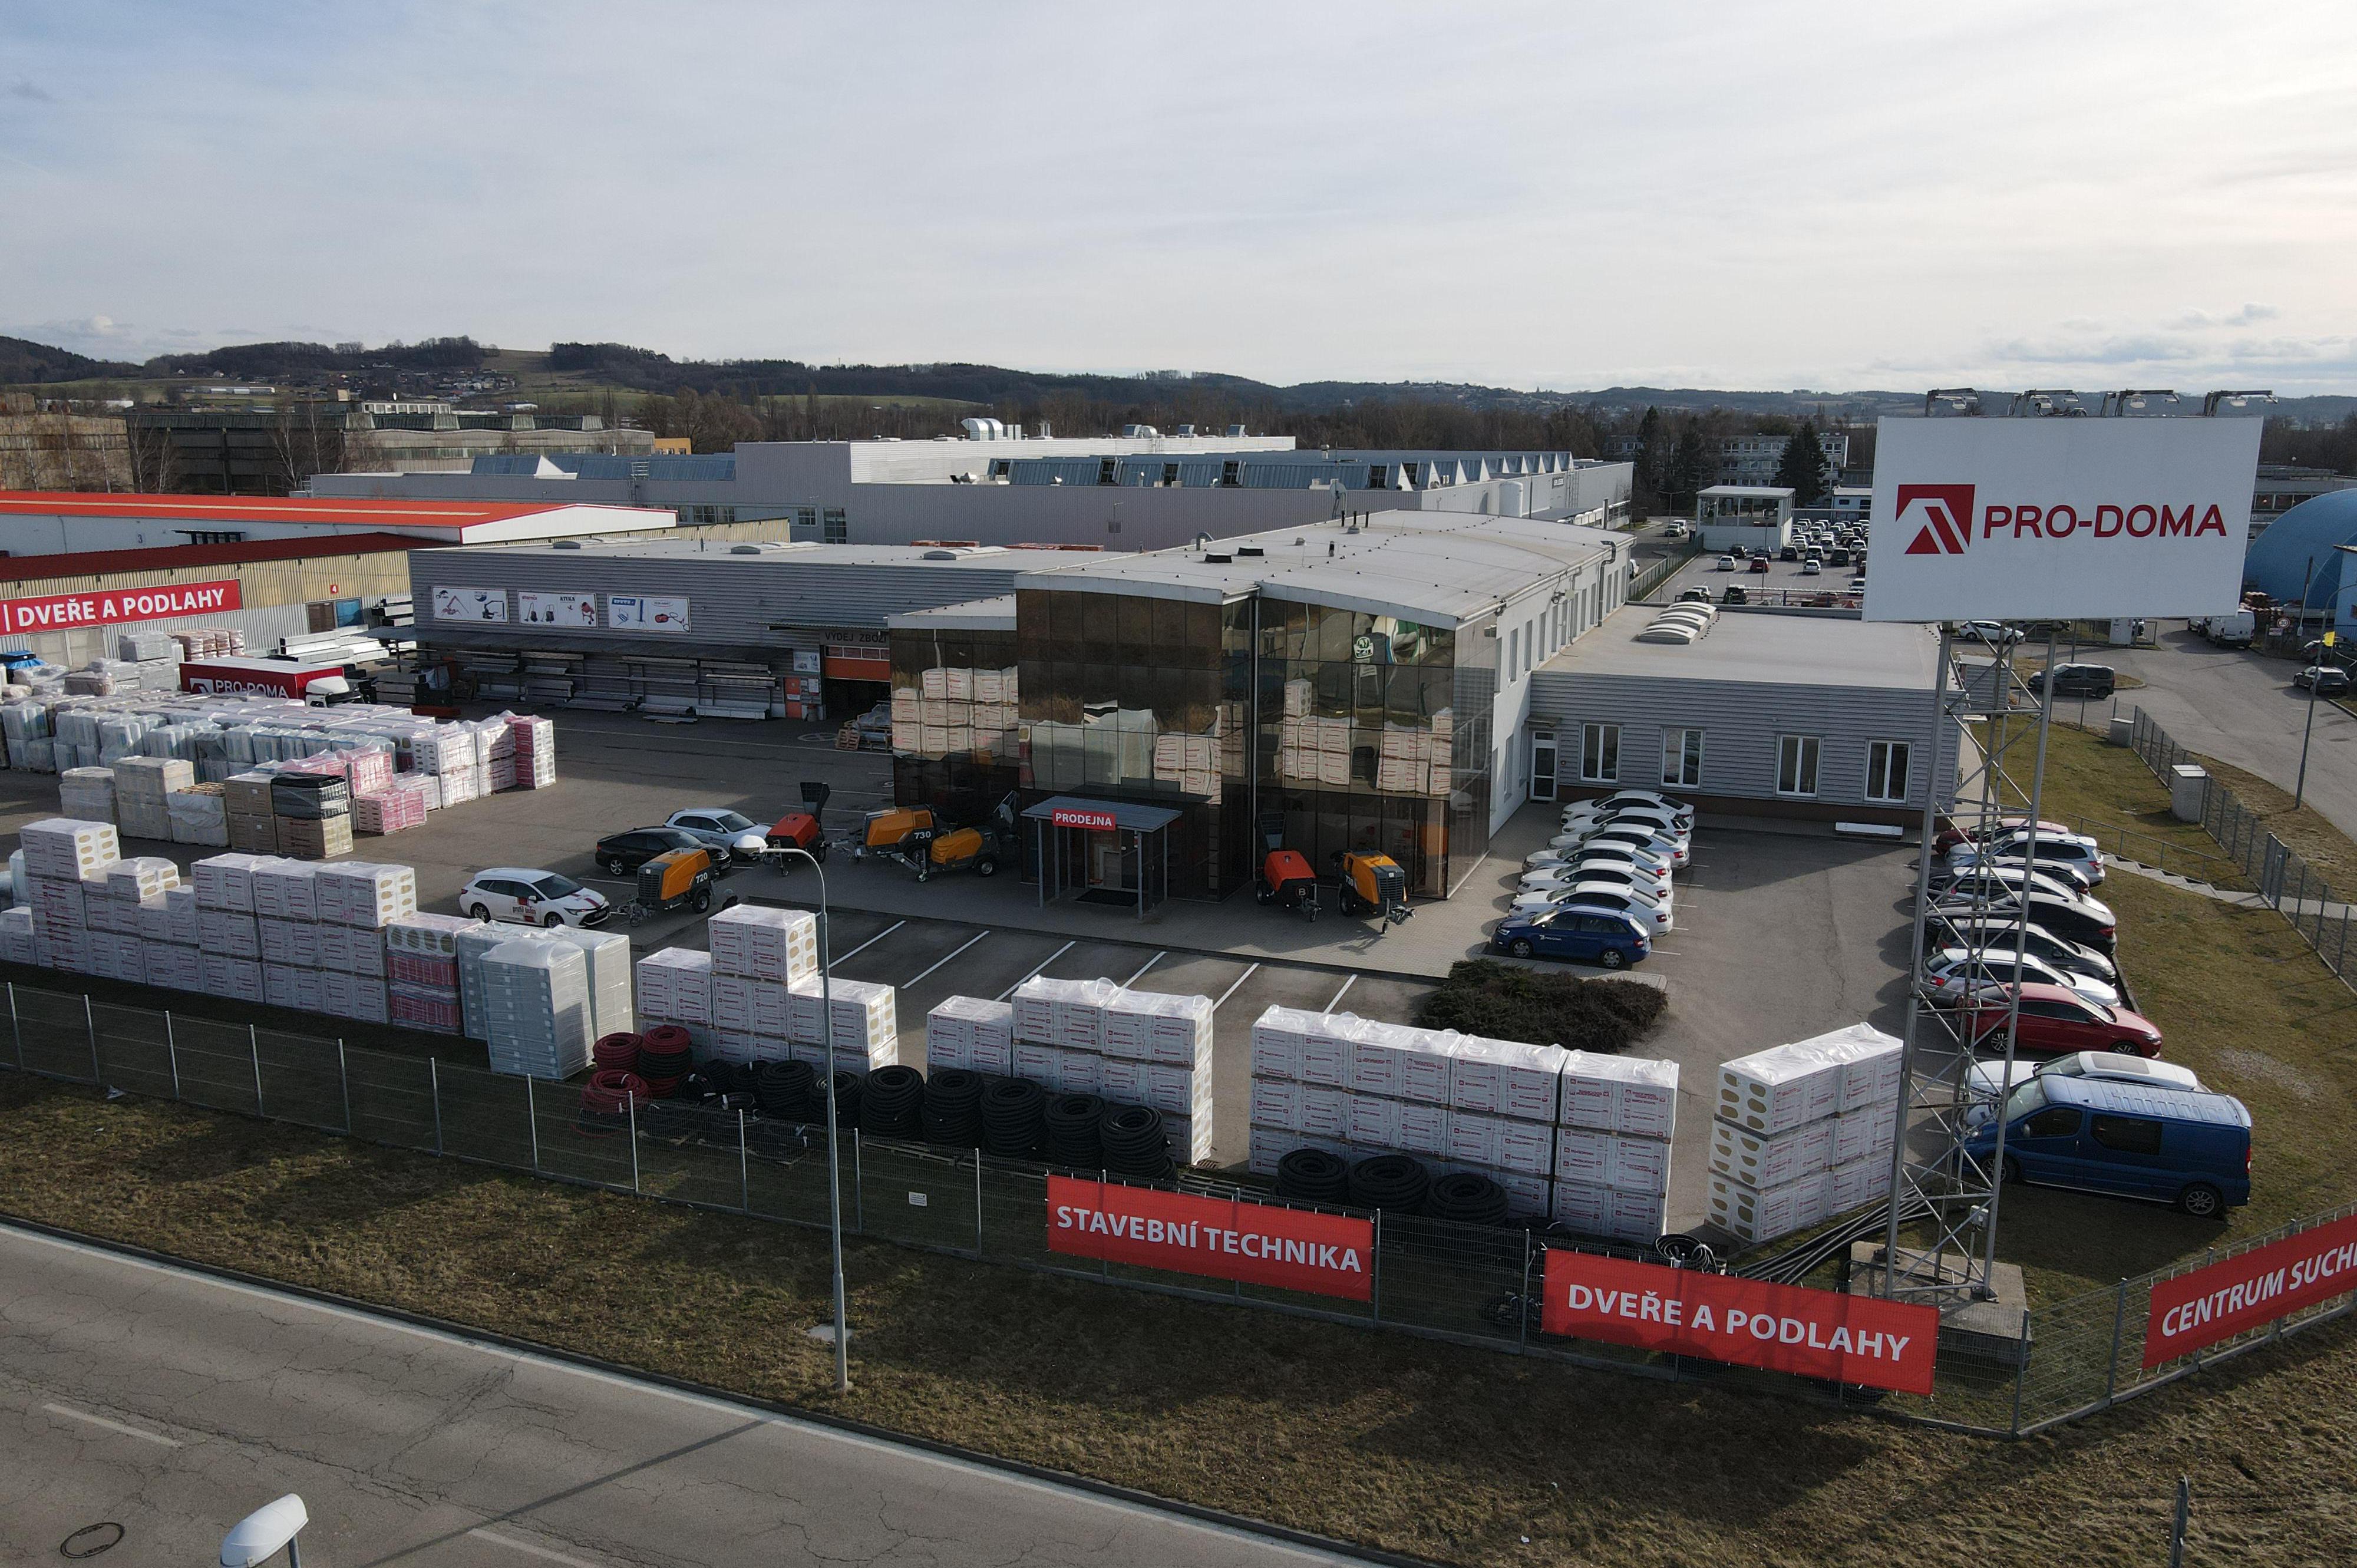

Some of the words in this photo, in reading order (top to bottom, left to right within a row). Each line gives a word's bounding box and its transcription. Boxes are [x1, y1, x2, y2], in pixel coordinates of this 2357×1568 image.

[138, 534, 143, 544] 3
[1983, 504, 2227, 539] PRO-DOMA
[17, 599, 96, 627] DVEŘE
[103, 599, 118, 618] A
[123, 588, 224, 616] PODLAHY
[914, 831, 931, 840] 730
[1055, 813, 1112, 826] PRODEJNA
[695, 872, 708, 883] 720
[1057, 1206, 1199, 1248] STAVEBNÍ
[1203, 1227, 1362, 1273] TECHNIKA
[2162, 1268, 2286, 1337] CENTRUM
[2289, 1243, 2357, 1290] SUCH
[1568, 1283, 1682, 1326] DVEŘE
[1691, 1305, 1715, 1332] A
[1726, 1309, 1910, 1361] PODLAHY
